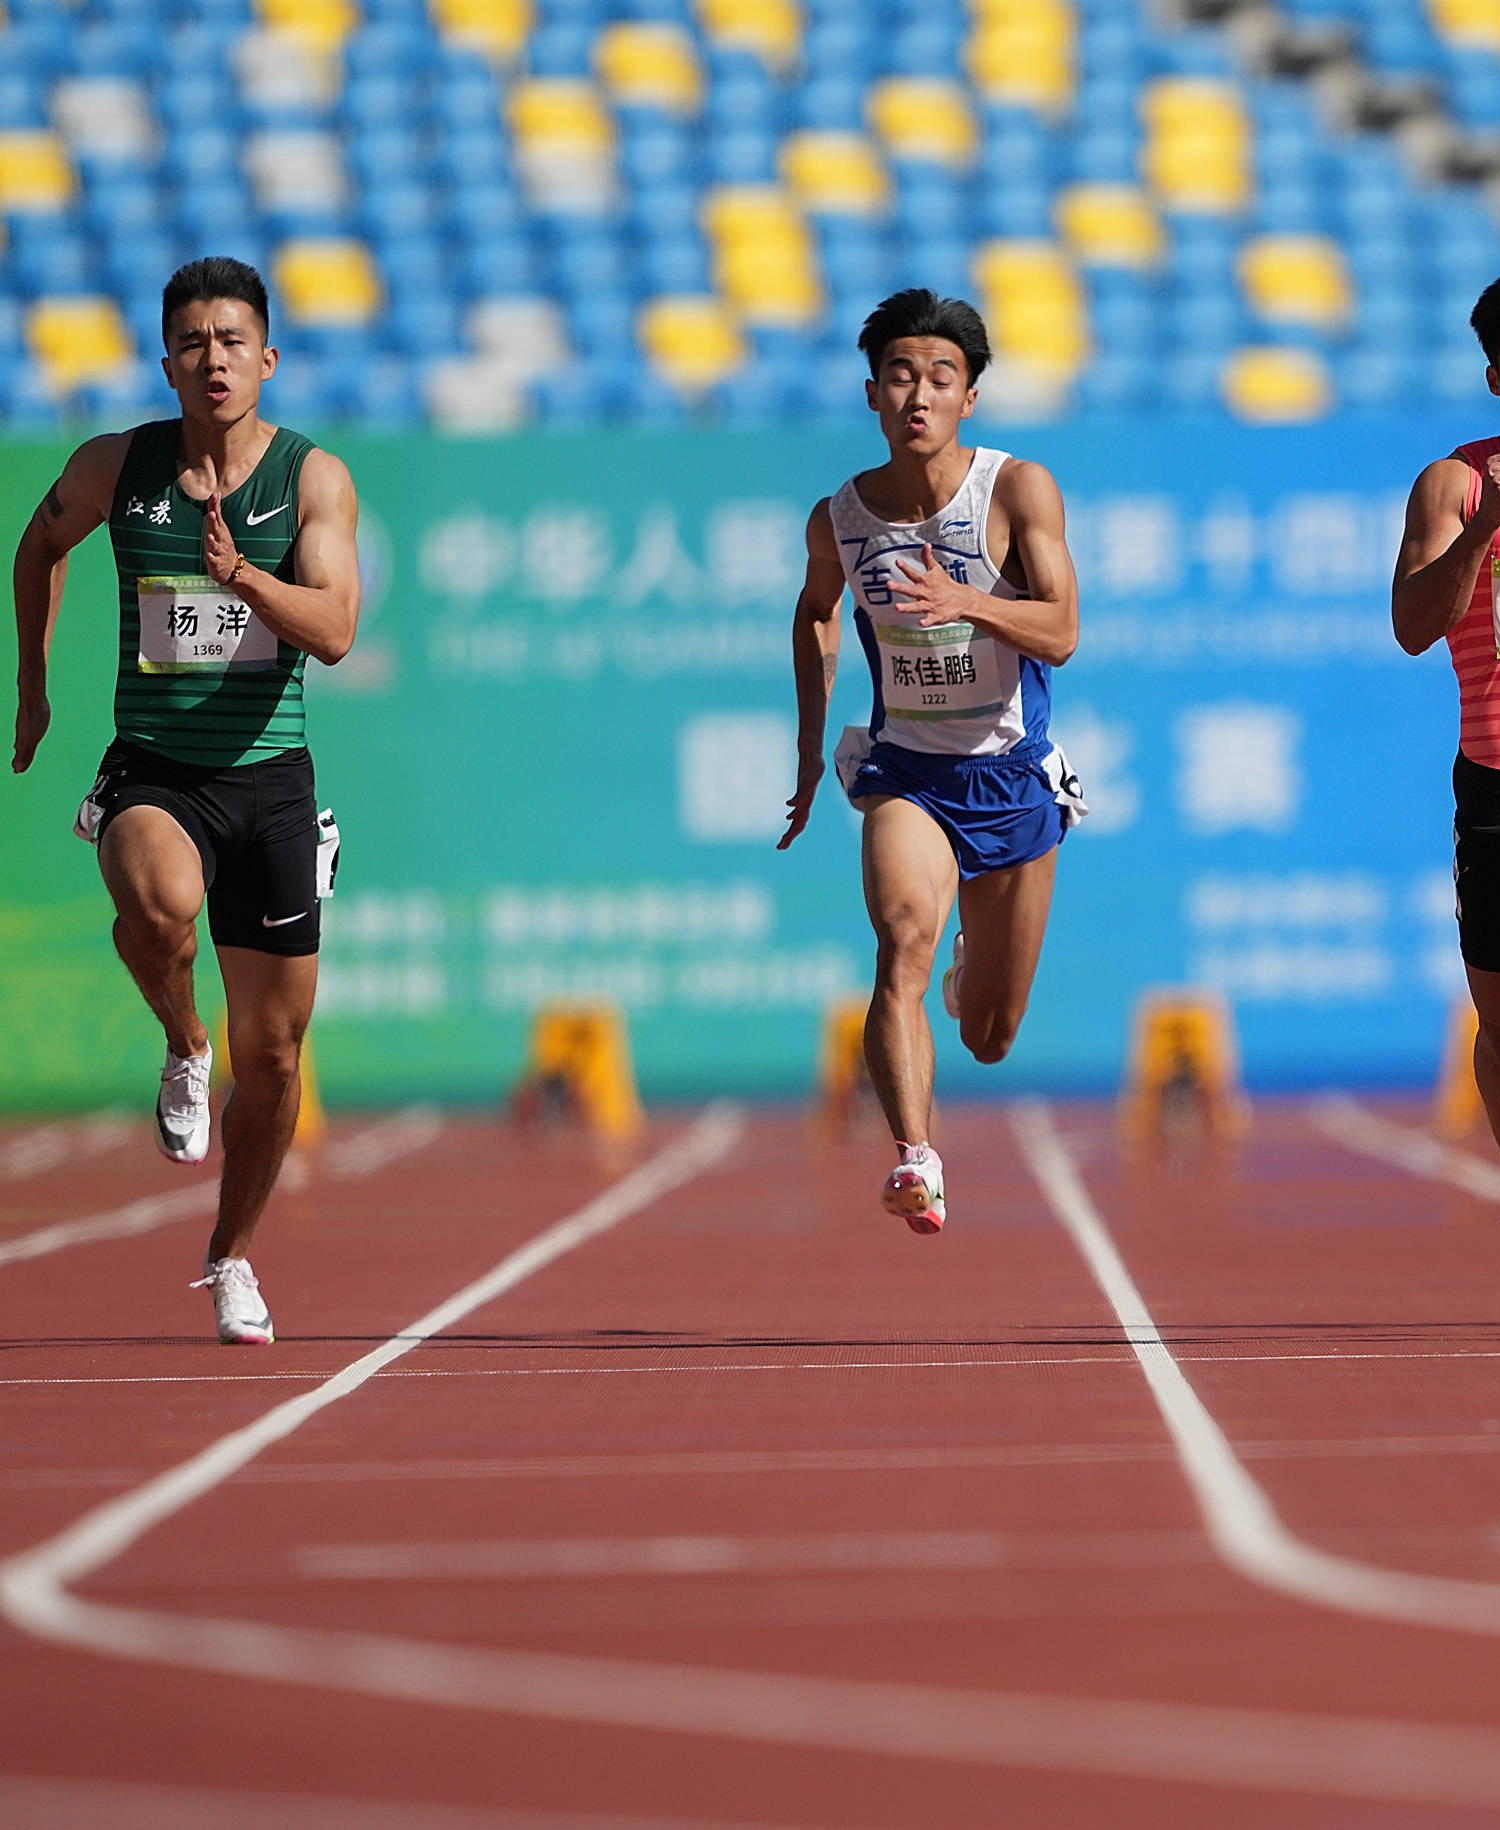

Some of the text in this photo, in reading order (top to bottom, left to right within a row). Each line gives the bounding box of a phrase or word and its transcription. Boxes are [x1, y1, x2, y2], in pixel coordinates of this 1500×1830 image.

[127, 497, 171, 524] 江苏
[193, 645, 223, 656] 1369
[891, 653, 976, 687] 陈佳鹏
[922, 694, 947, 705] 1222
